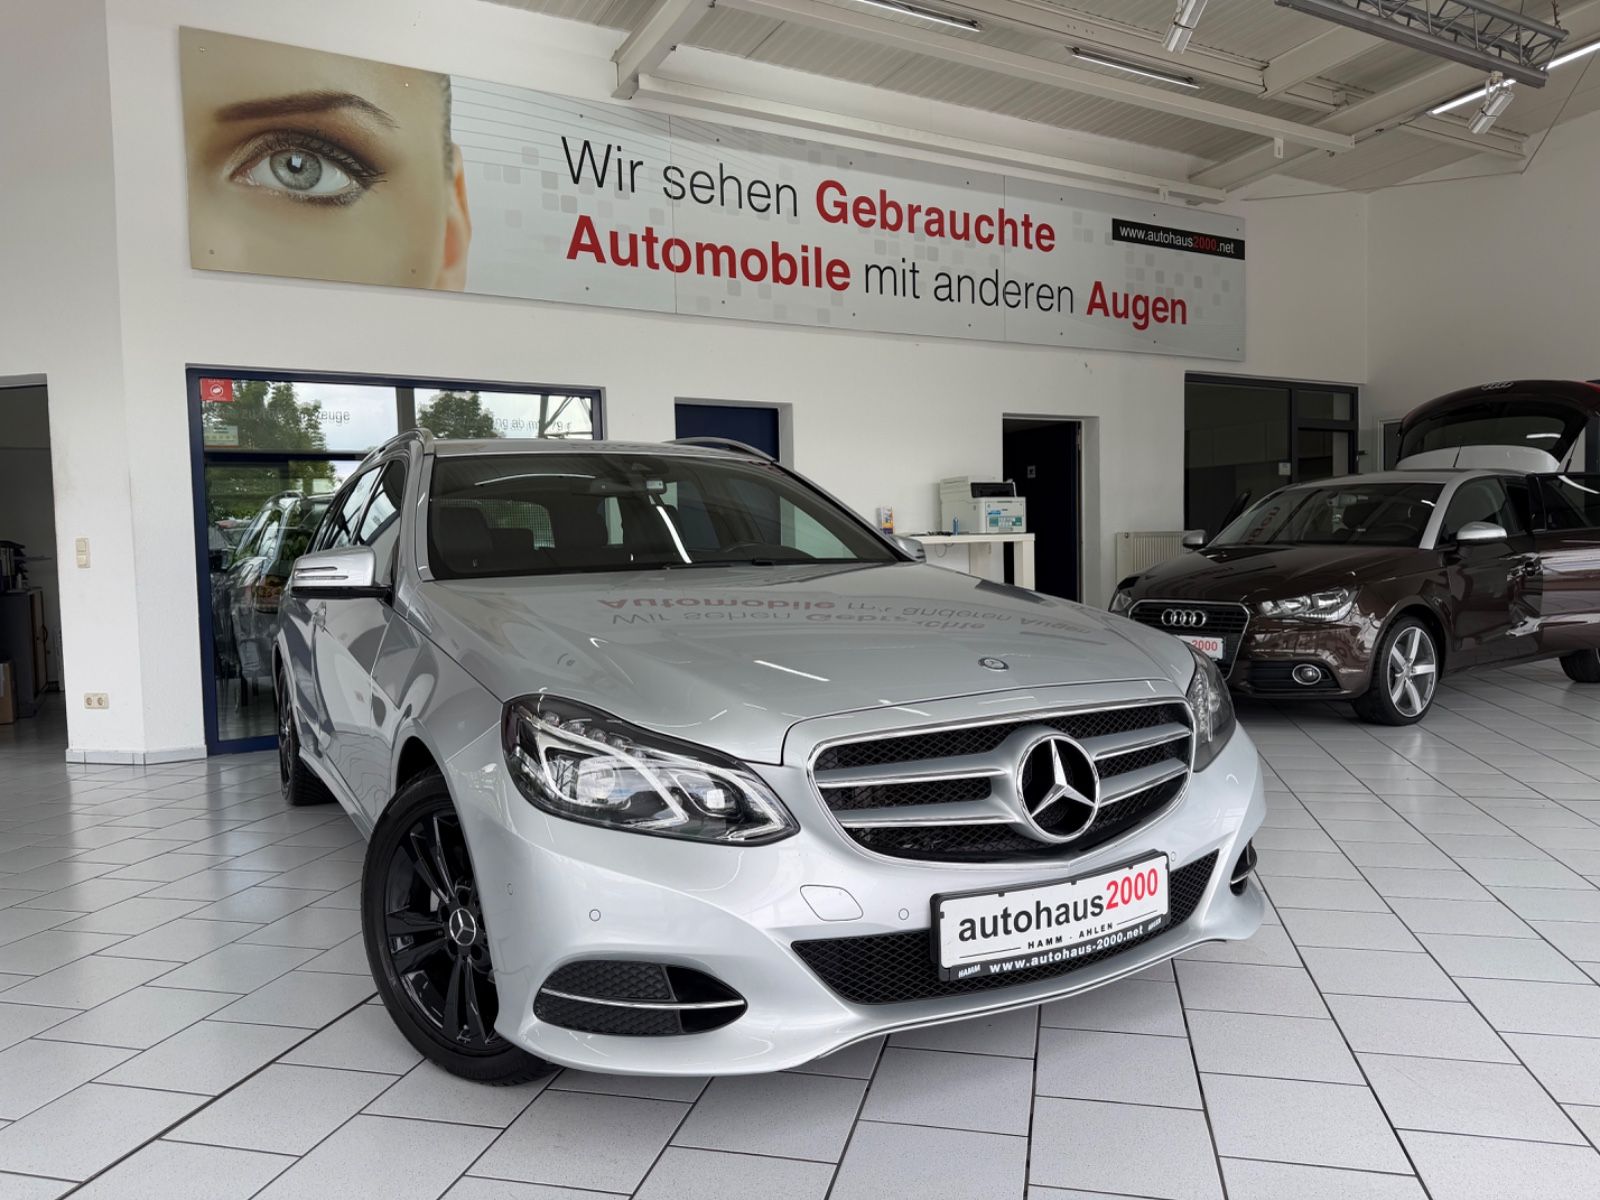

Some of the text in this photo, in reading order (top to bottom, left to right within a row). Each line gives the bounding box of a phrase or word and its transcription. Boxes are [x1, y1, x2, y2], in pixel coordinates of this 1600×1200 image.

[561, 136, 1056, 252] Wir sehen Gebrauchte
[1119, 225, 1235, 254] www.autohaus2000.net
[566, 214, 1188, 330] Automobile mit anderen Augen
[958, 868, 1159, 941] autohaus2000
[989, 925, 1144, 974] www.autohaus-2000.net
[1027, 935, 1063, 949] HAMM
[1079, 922, 1114, 939] AHLEN
